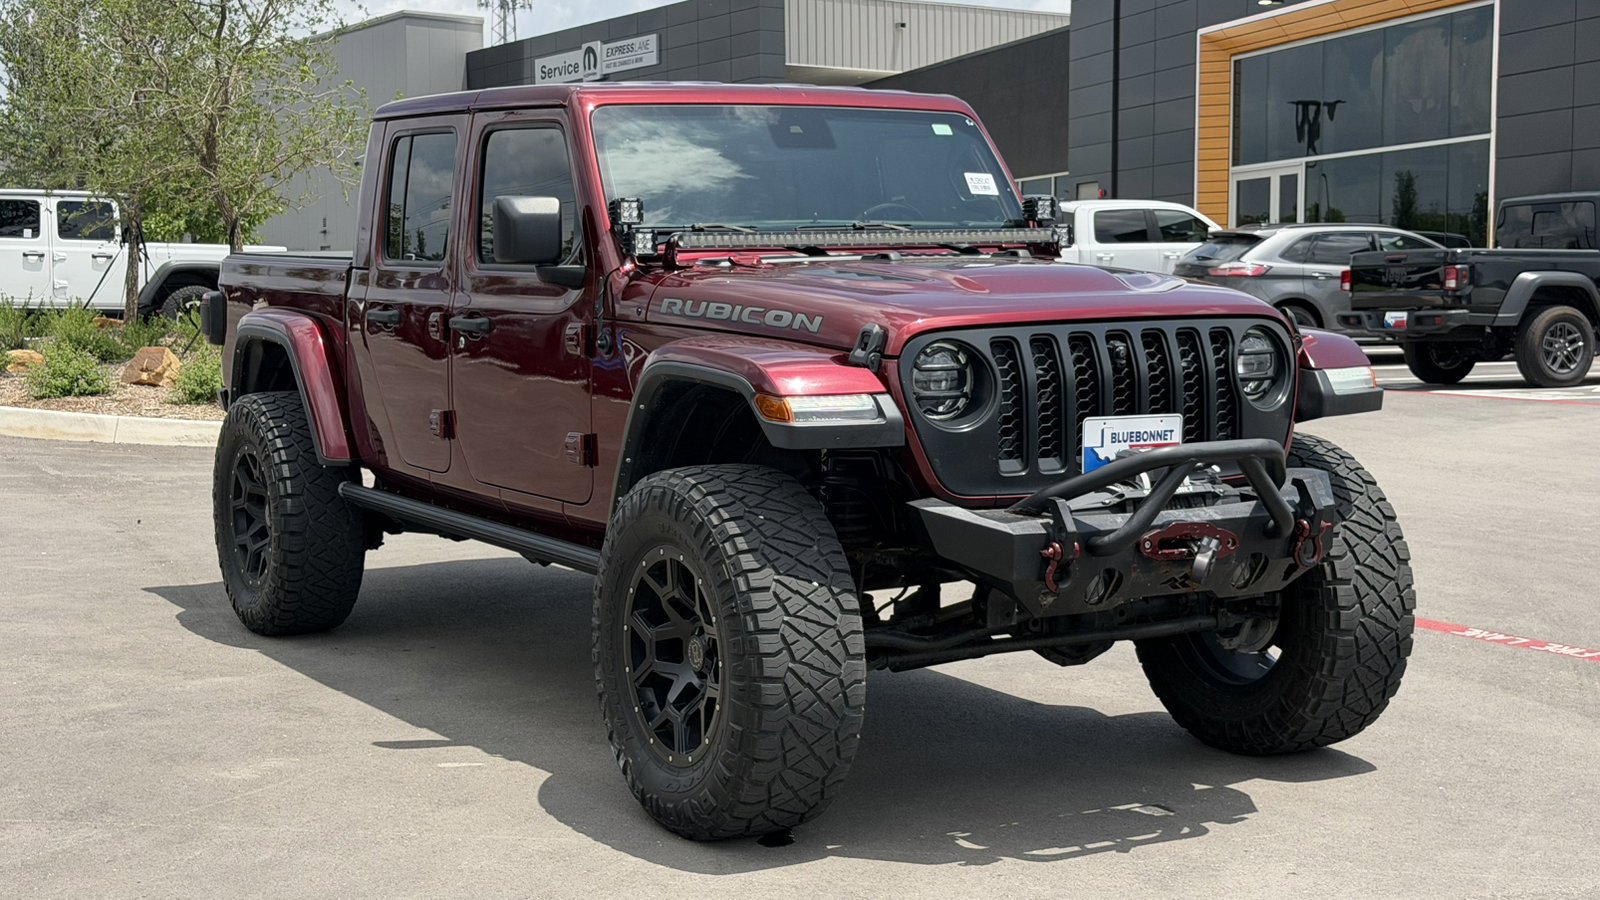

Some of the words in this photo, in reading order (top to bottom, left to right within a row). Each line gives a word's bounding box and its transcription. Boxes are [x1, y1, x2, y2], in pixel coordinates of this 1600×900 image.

[540, 61, 579, 80] Service
[660, 298, 823, 333] RUBICON
[1110, 429, 1174, 444] BLUEBONNET
